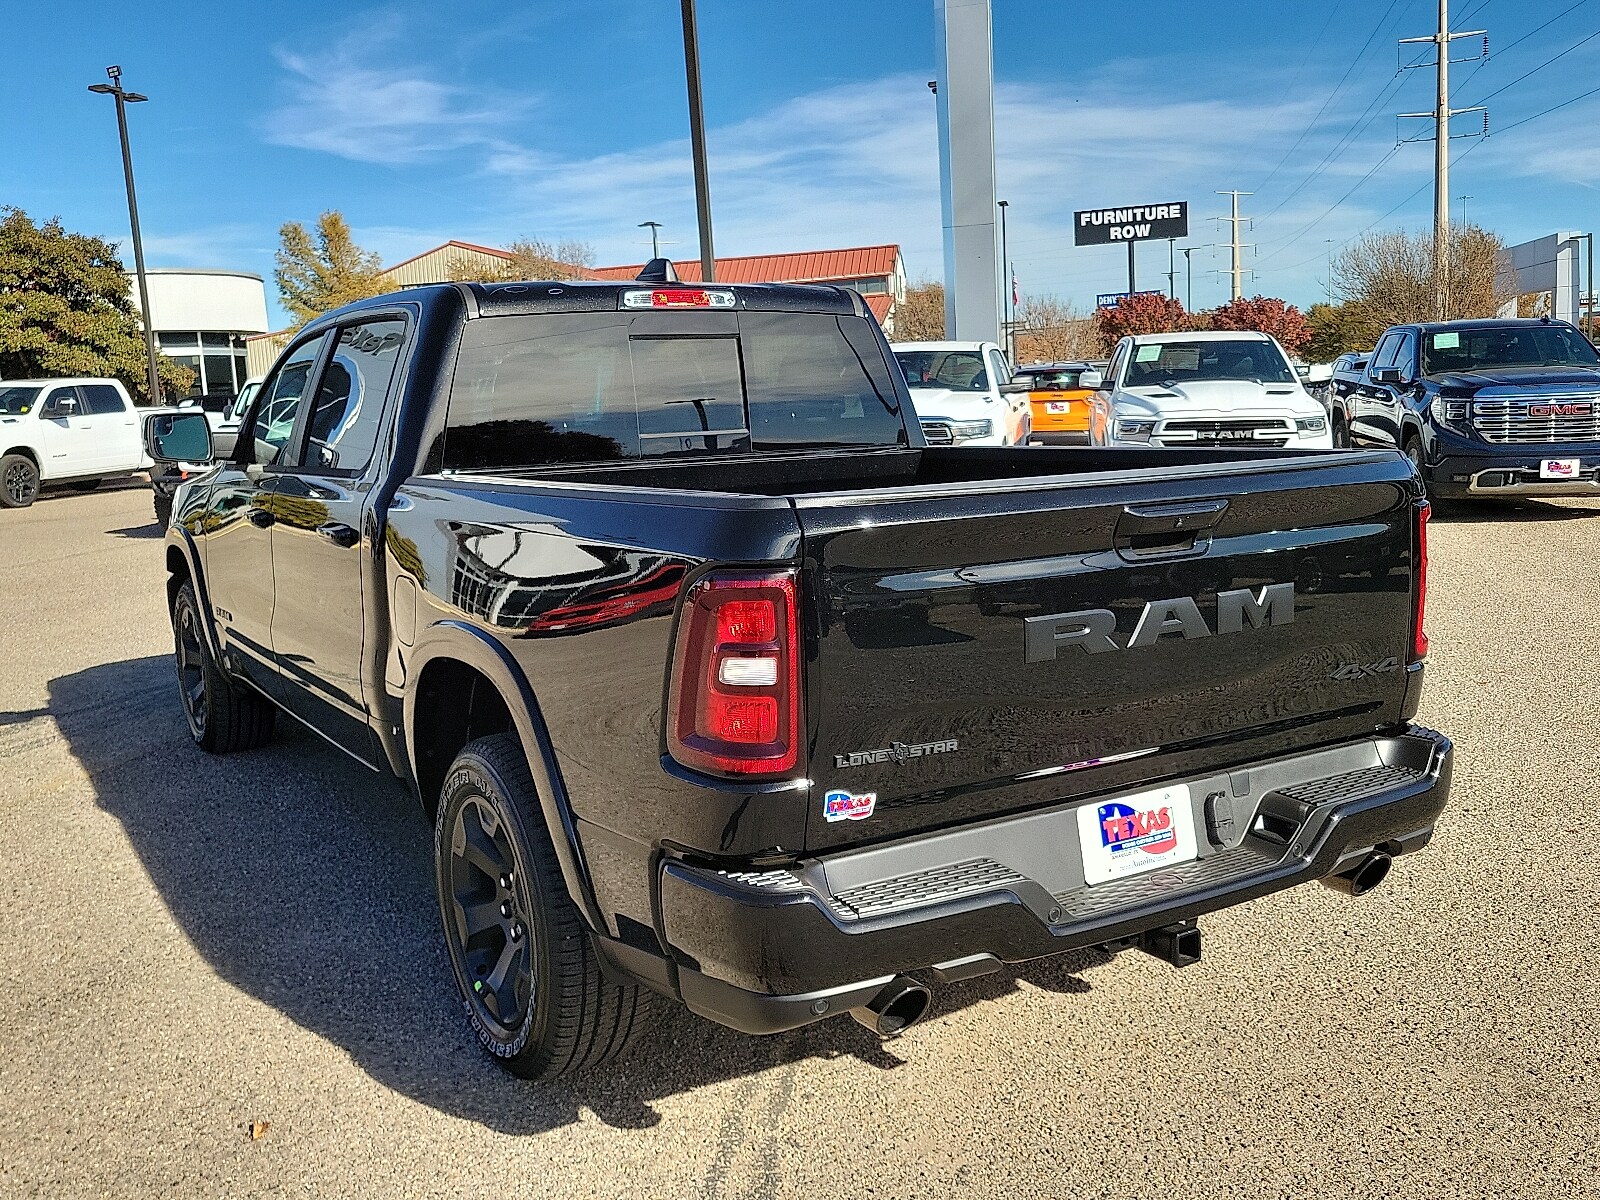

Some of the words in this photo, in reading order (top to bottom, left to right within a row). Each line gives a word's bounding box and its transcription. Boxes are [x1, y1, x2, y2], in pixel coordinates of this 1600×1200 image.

[1080, 205, 1181, 226] FURNITURE
[1109, 223, 1151, 240] ROW
[1530, 404, 1591, 416] GMC
[1197, 430, 1252, 440] RAM
[1024, 582, 1295, 664] RAM
[833, 749, 891, 769] LONE
[908, 739, 959, 758] STAR
[829, 797, 871, 812] TEXAS
[1102, 806, 1171, 843] TEXAS
